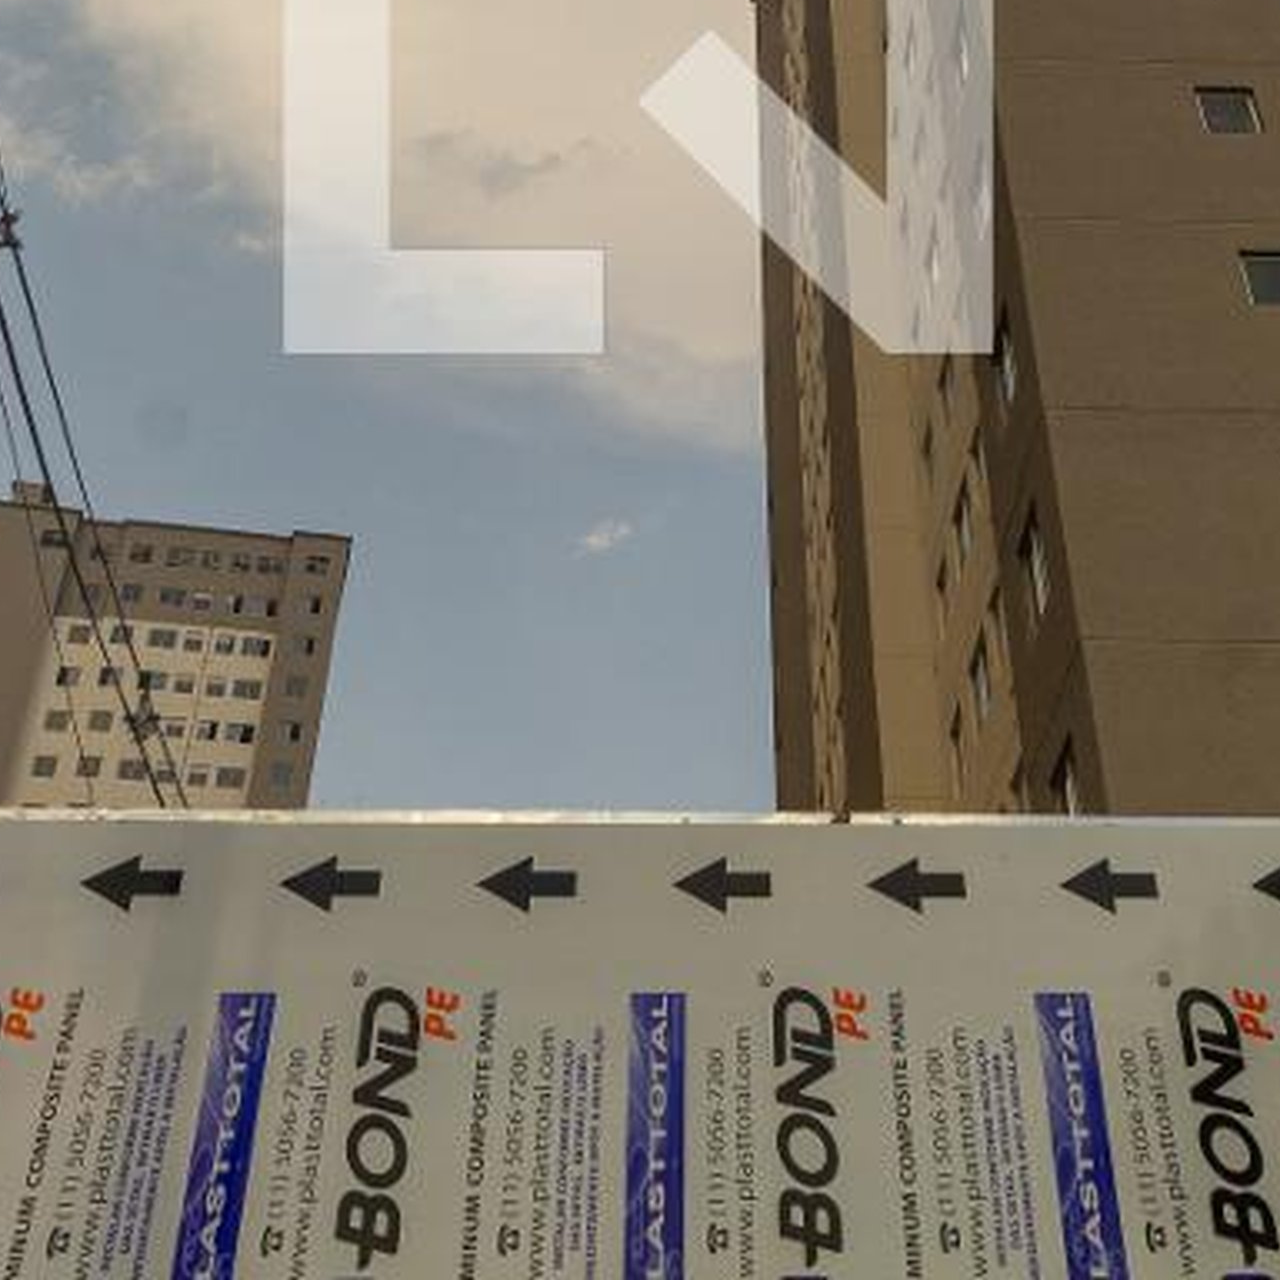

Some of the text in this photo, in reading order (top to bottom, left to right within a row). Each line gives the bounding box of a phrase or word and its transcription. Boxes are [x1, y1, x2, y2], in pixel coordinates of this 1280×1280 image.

[2, 988, 47, 1041] PE
[420, 988, 461, 1041] PE
[476, 990, 500, 1051] PANEL
[834, 988, 870, 1041] PE
[887, 990, 907, 1051] PANEL
[1233, 988, 1275, 1041] PE
[21, 1060, 69, 1188] COMPOSITE
[53, 988, 85, 1051] PANEL
[463, 1060, 494, 1186] COMPOSITE
[888, 1059, 917, 1185] COMPOSITE
